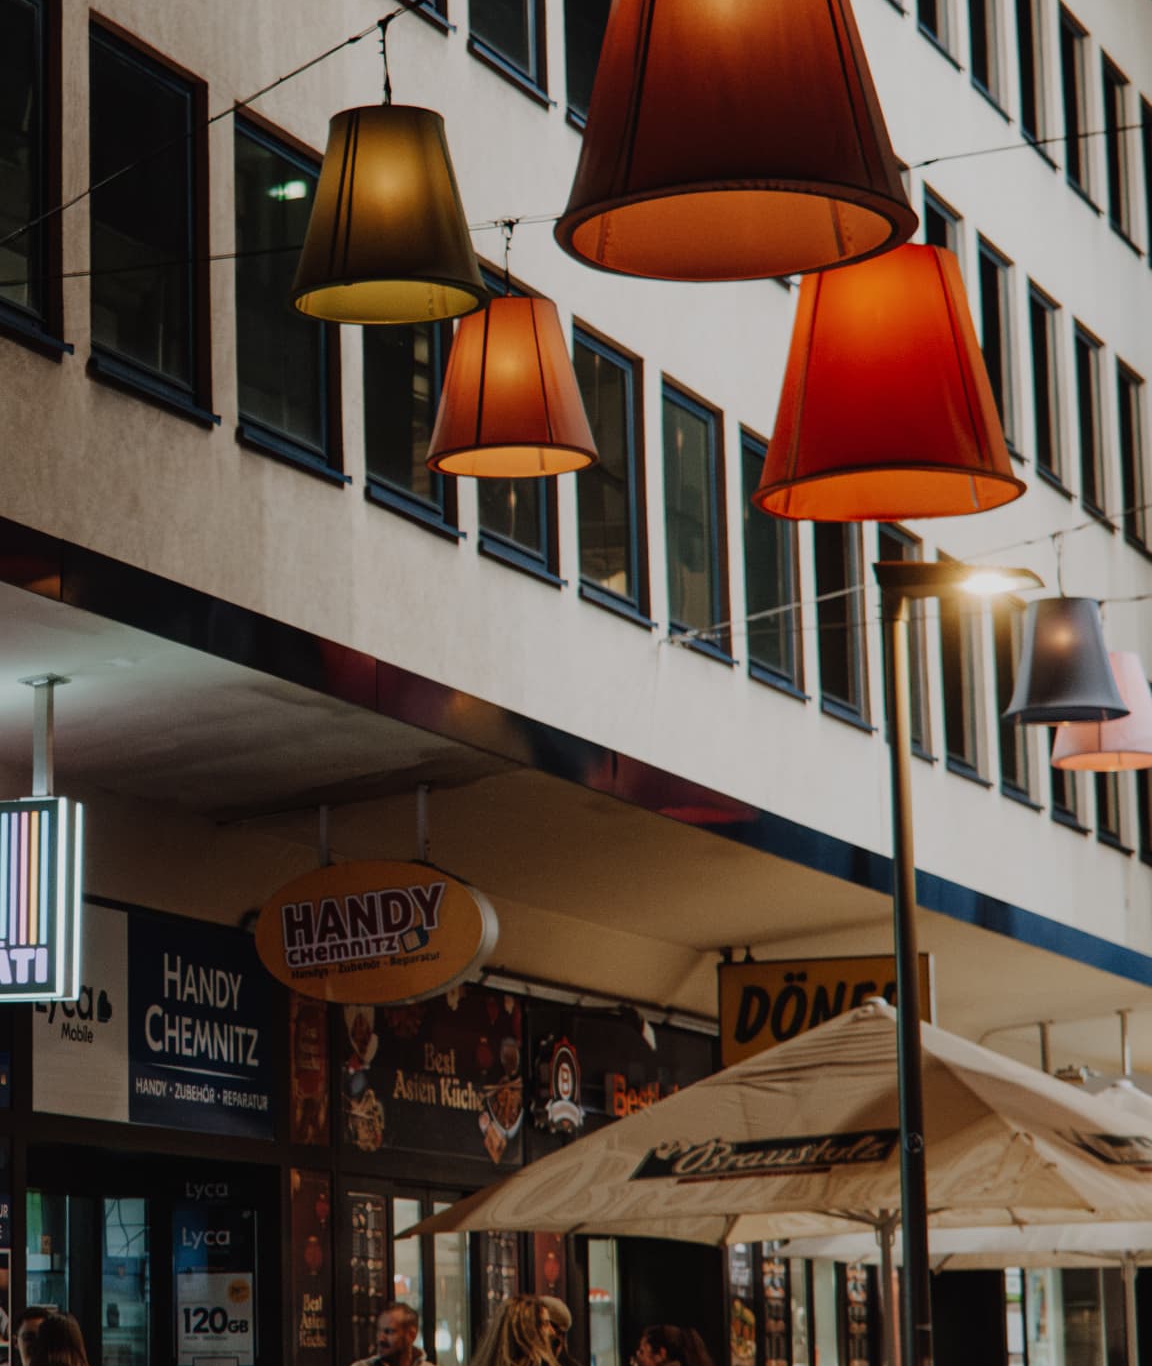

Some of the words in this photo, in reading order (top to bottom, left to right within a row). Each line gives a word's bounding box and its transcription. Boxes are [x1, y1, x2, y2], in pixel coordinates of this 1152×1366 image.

[282, 881, 446, 949] HANDY
[163, 951, 243, 1012] HANDY
[61, 1022, 94, 1044] Mobile
[144, 1003, 260, 1068] CHEMNITZ
[424, 1042, 456, 1075] Best
[135, 1076, 168, 1098] HANDY
[174, 1081, 216, 1105] ZUBEHÖR
[221, 1088, 269, 1112] REPARATUR
[392, 1068, 437, 1104] Asien
[185, 1180, 229, 1201] Lyca
[181, 1226, 231, 1250] Lyca
